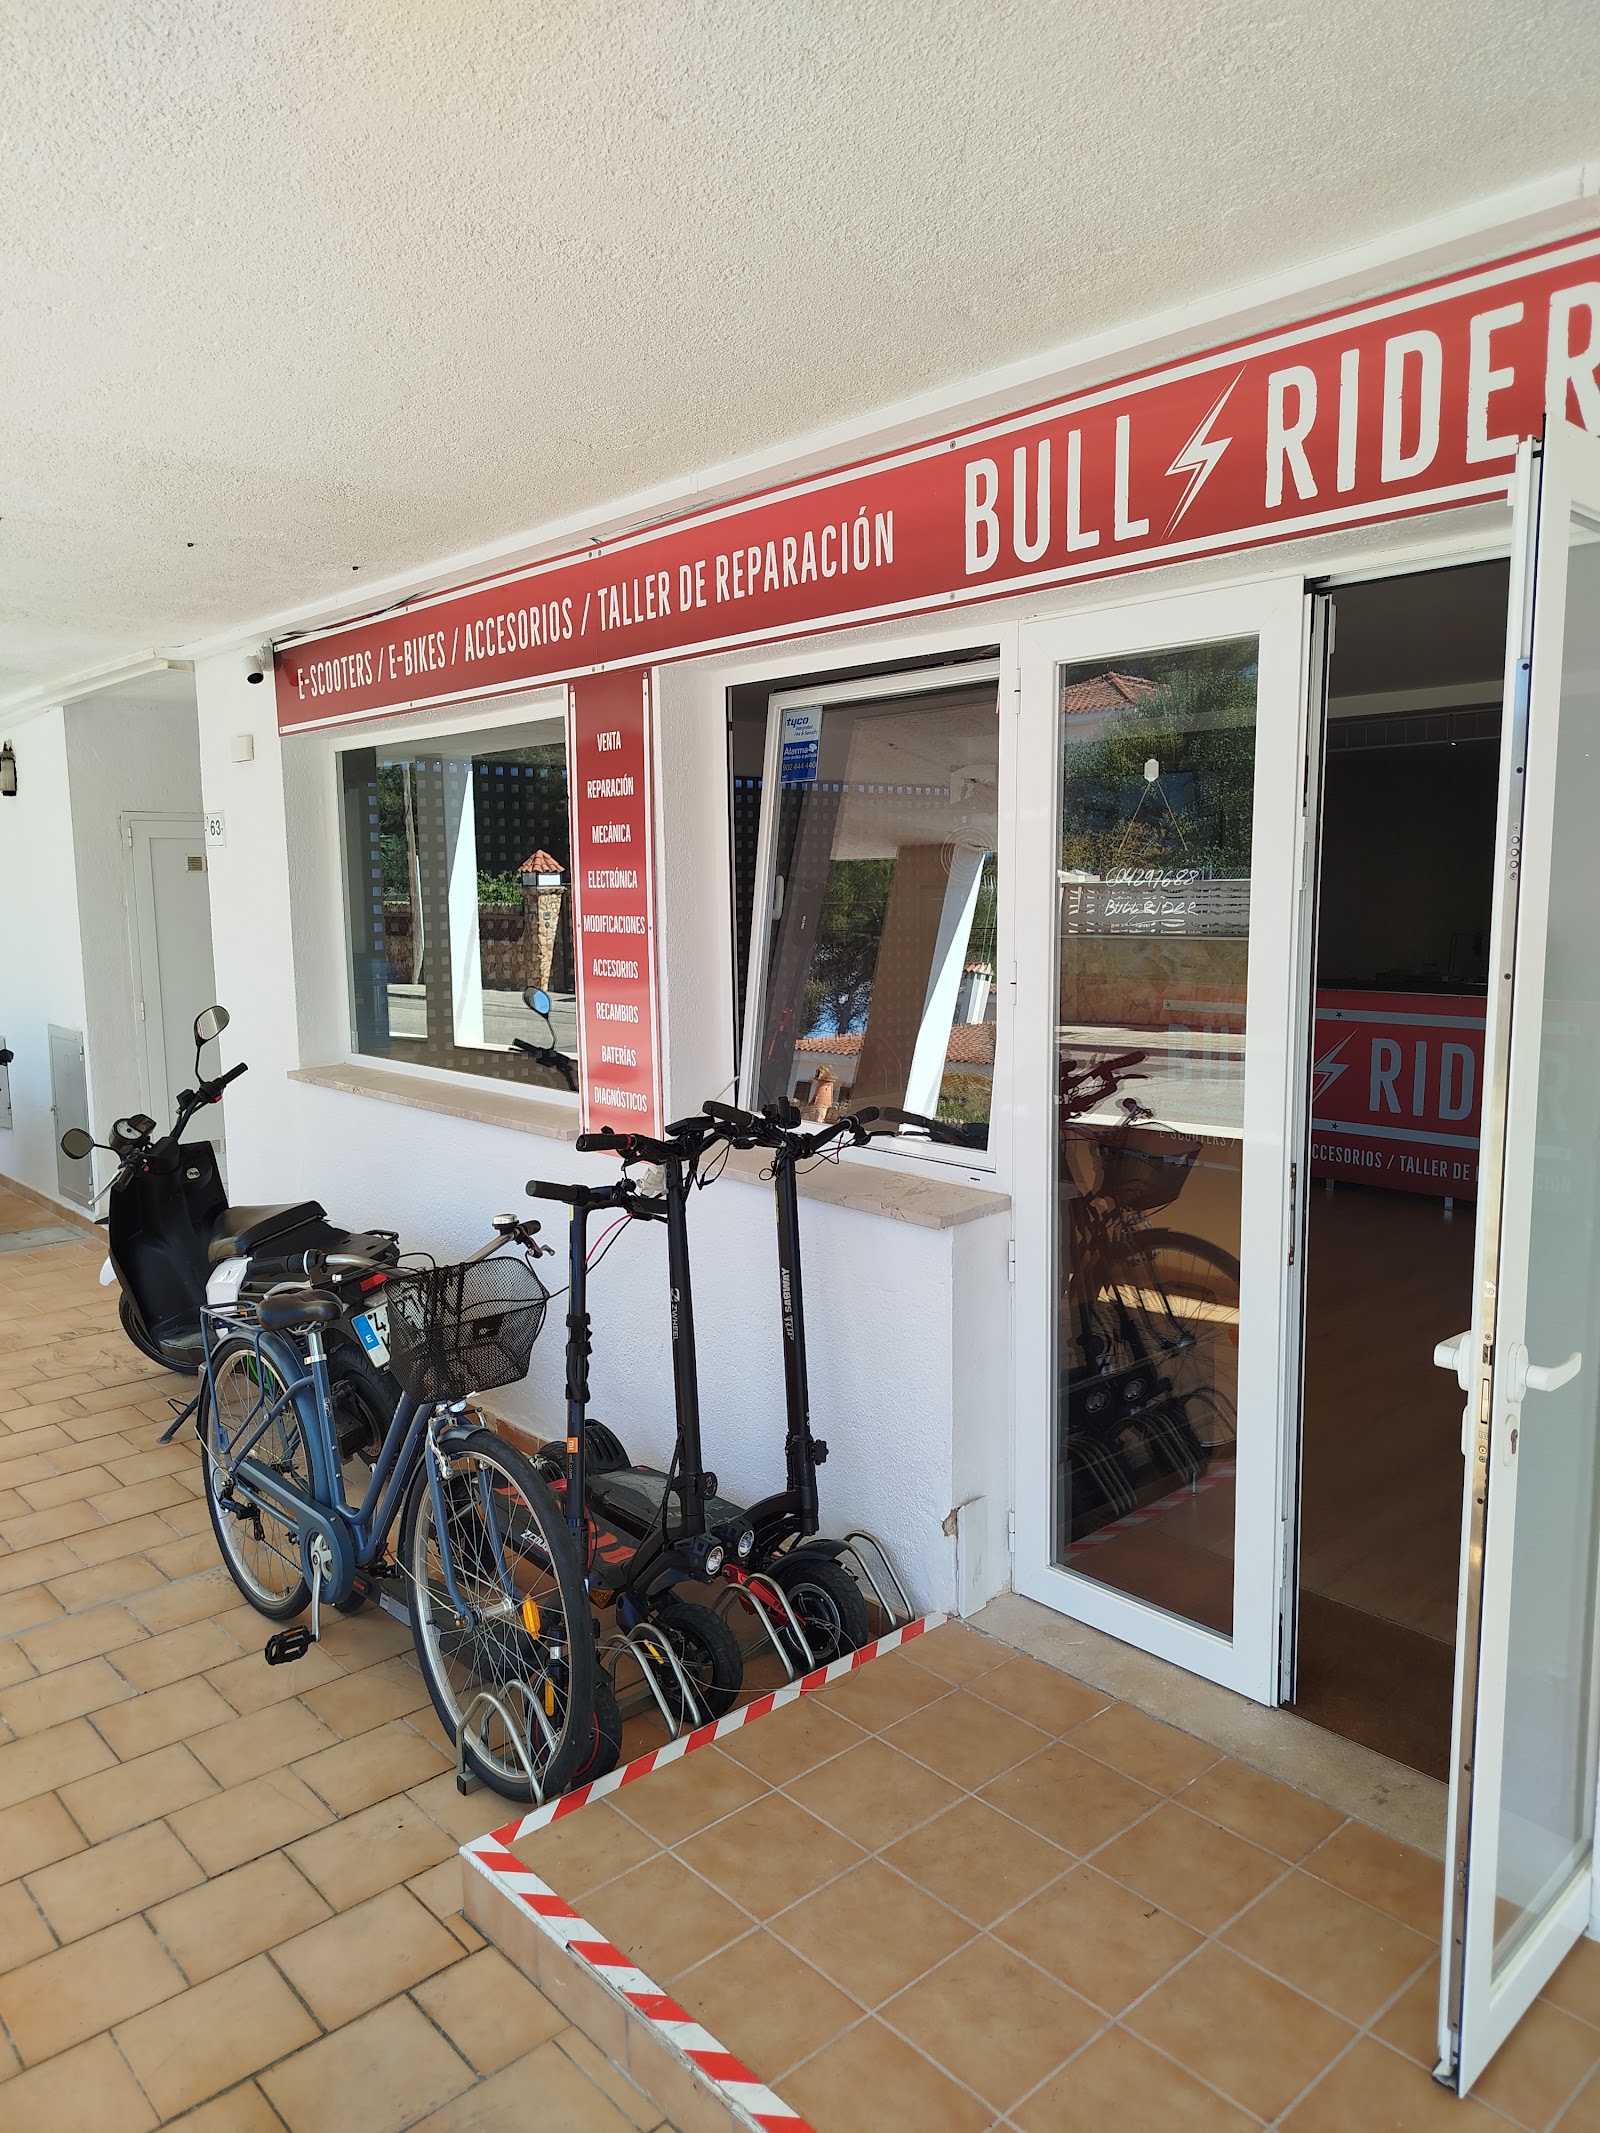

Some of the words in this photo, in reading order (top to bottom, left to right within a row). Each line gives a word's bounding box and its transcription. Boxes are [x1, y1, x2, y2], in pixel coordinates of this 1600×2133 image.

[964, 413, 1150, 576] BULL
[1264, 280, 1600, 508] RIDER
[297, 651, 373, 701] E-SCOOTERS
[387, 632, 446, 680] E-BIKES
[464, 598, 573, 664] ACCESORIOS
[598, 574, 672, 632] TALLER
[678, 560, 706, 610] DE
[715, 505, 895, 603] REPARACIÓN
[786, 716, 809, 728] tyco
[597, 730, 622, 752] VENTA
[784, 746, 808, 756] Alarma
[783, 763, 793, 771] 902
[793, 762, 804, 770] 444
[805, 761, 816, 769] 440
[587, 773, 634, 799] REPARACIÓN
[210, 819, 221, 836] 63
[591, 820, 632, 844] MECÁNICA
[587, 866, 638, 889] ELECTRÓNICA
[583, 914, 646, 935] MODIFICACIONES
[592, 958, 639, 979] ACCESORIOS
[595, 1001, 639, 1024] RECAMBIOS
[601, 1044, 637, 1067] BATERÍAS
[1369, 1037, 1476, 1121] RID
[594, 1086, 648, 1113] DIAGNÓSTICOS
[1311, 1143, 1383, 1169] CCESORIOS
[1399, 1155, 1448, 1178] TALLER
[1453, 1163, 1470, 1181] DE
[781, 1266, 792, 1313] SABWAY
[365, 1334, 374, 1343] E
